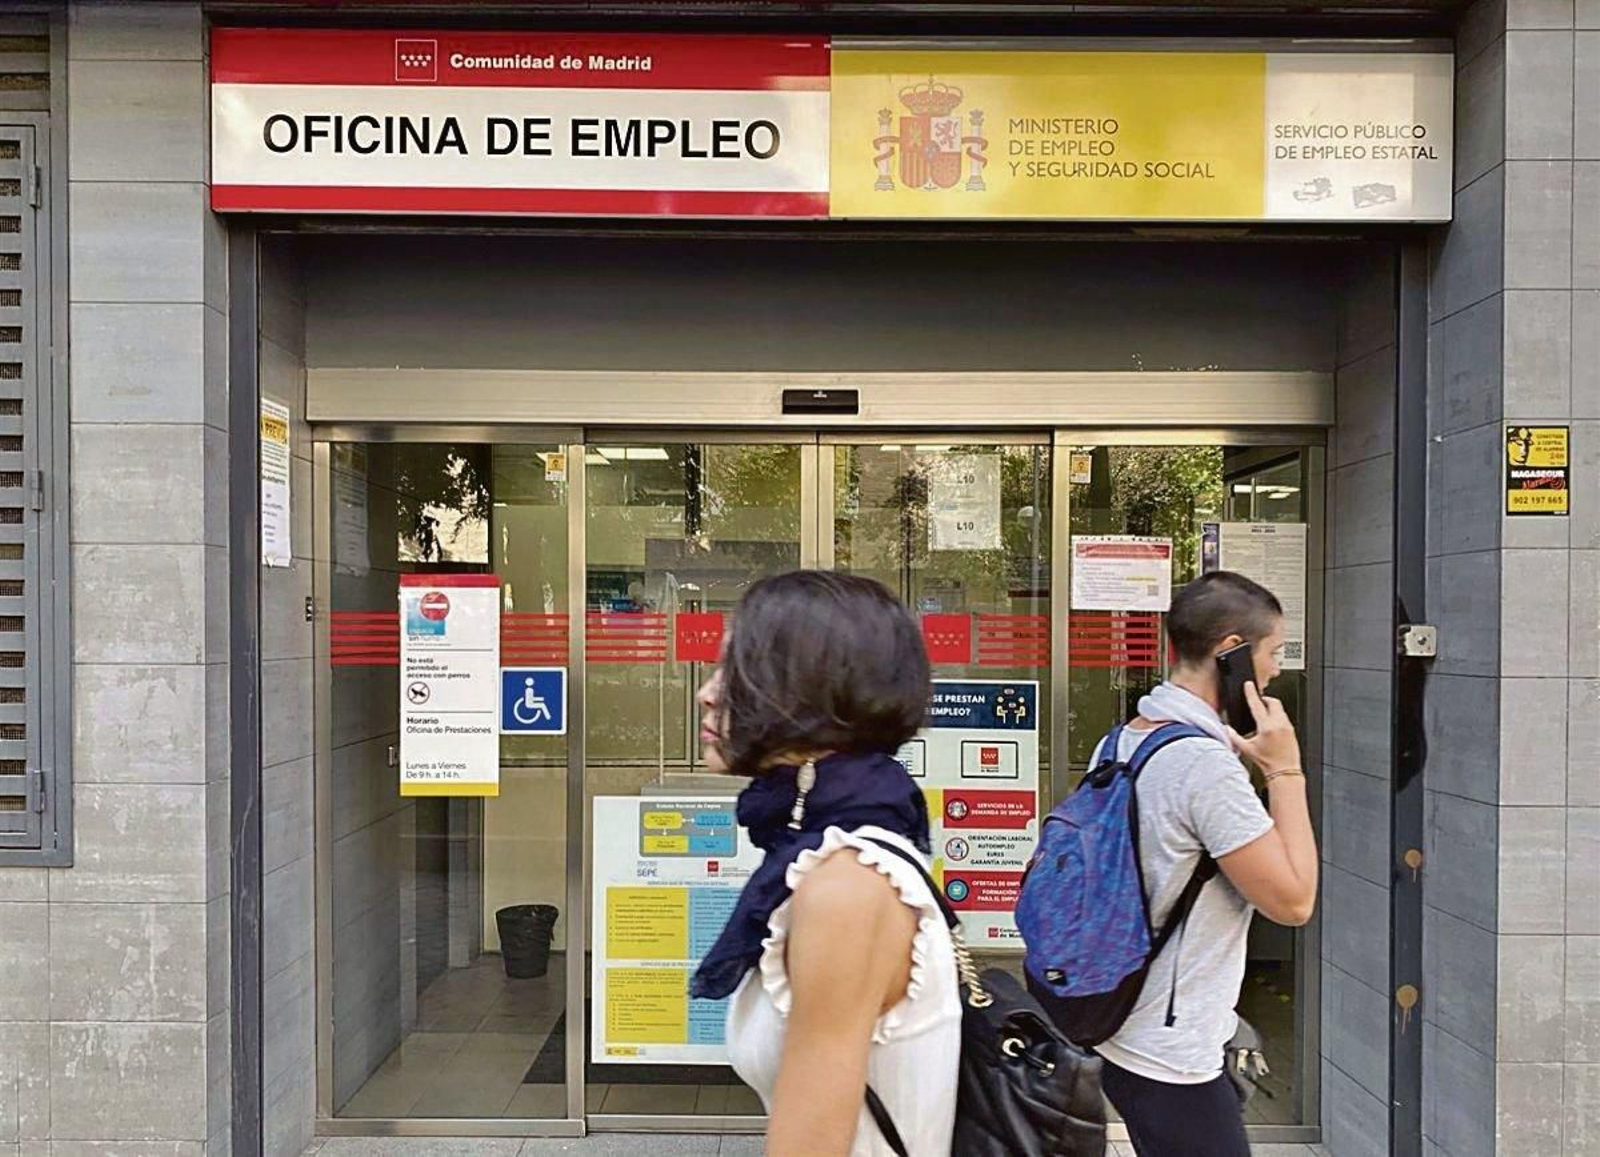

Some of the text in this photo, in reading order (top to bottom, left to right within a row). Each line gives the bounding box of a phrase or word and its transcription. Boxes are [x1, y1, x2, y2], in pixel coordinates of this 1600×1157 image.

[450, 53, 652, 71] Comunidad de Madrid
[1008, 118, 1119, 135] MINISTERIO
[1274, 121, 1426, 139] SERVICIO PÚBLICO
[263, 114, 781, 160] OFICINA DE EMPLEO
[1008, 140, 1115, 156] DE EMPLEO
[1275, 145, 1438, 160] DE EMPLEO ESTATAL
[1008, 161, 1215, 178] Y SEGURIDAD SOCIAL
[956, 522, 974, 531] L10
[932, 694, 986, 704] SE PRESTAN
[931, 707, 972, 717] EMPLEO?
[406, 717, 439, 725] Horario
[406, 725, 492, 734] Oficina de Prestaciones
[405, 761, 430, 770] Lunes
[438, 761, 467, 770] Viernes
[405, 771, 417, 779] De
